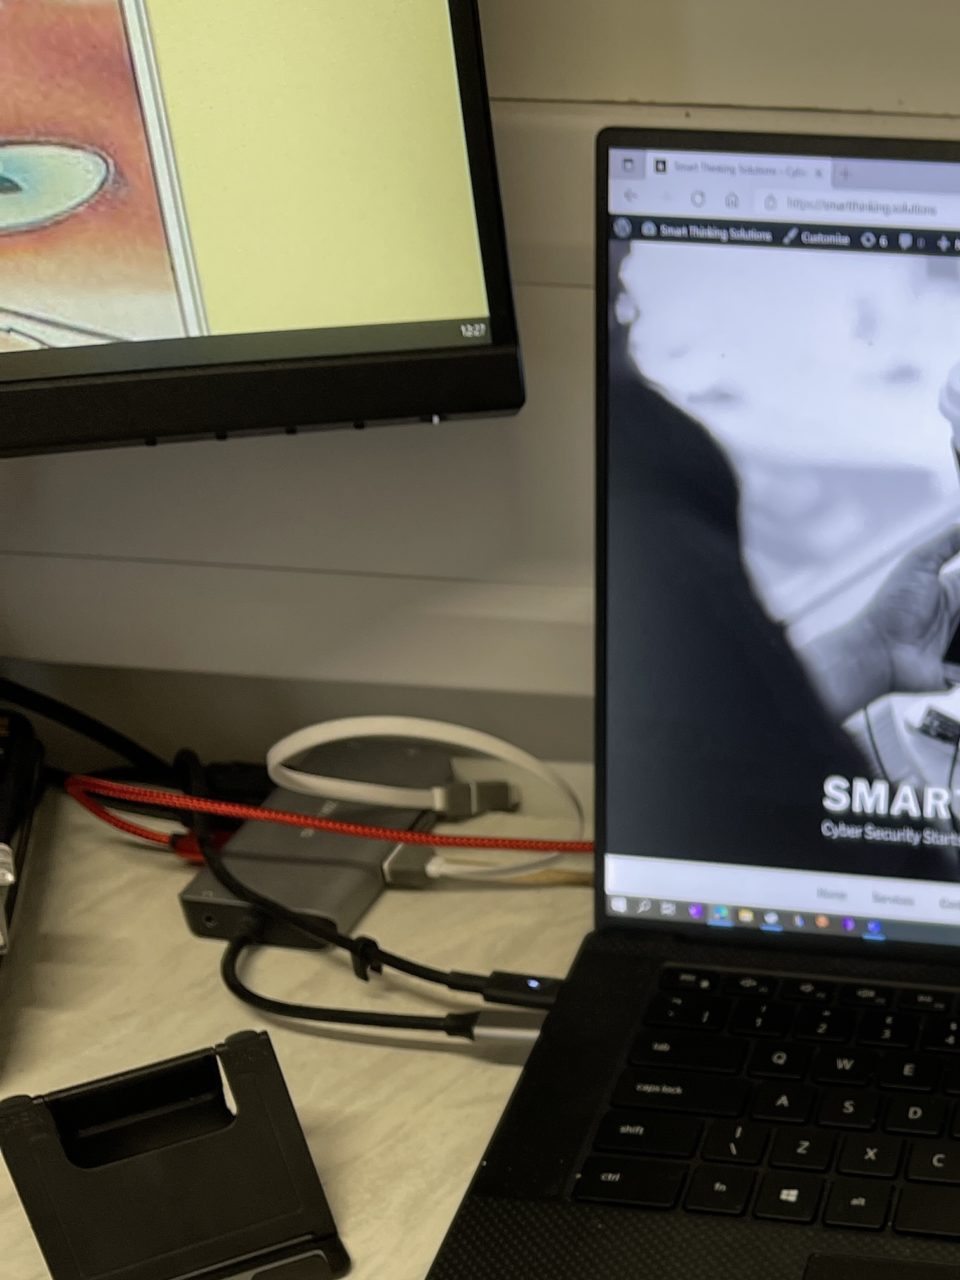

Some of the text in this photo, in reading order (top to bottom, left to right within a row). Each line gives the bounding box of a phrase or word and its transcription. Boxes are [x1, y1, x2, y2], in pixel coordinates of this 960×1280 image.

[660, 224, 773, 243] Smart Thinking Solutions
[820, 819, 863, 840] Cyber
[863, 821, 921, 846] Security
[771, 1051, 788, 1066] Q
[836, 1058, 855, 1071] W
[902, 1063, 915, 1077] E
[775, 1094, 790, 1108] A
[842, 1100, 855, 1114] S
[907, 1106, 923, 1120] D
[619, 1124, 645, 1136] shift
[796, 1140, 811, 1155] Z
[863, 1147, 878, 1161] X
[931, 1153, 946, 1168] C
[600, 1172, 621, 1182] ctrl
[713, 1181, 727, 1192] fn
[850, 1196, 866, 1207] alt
